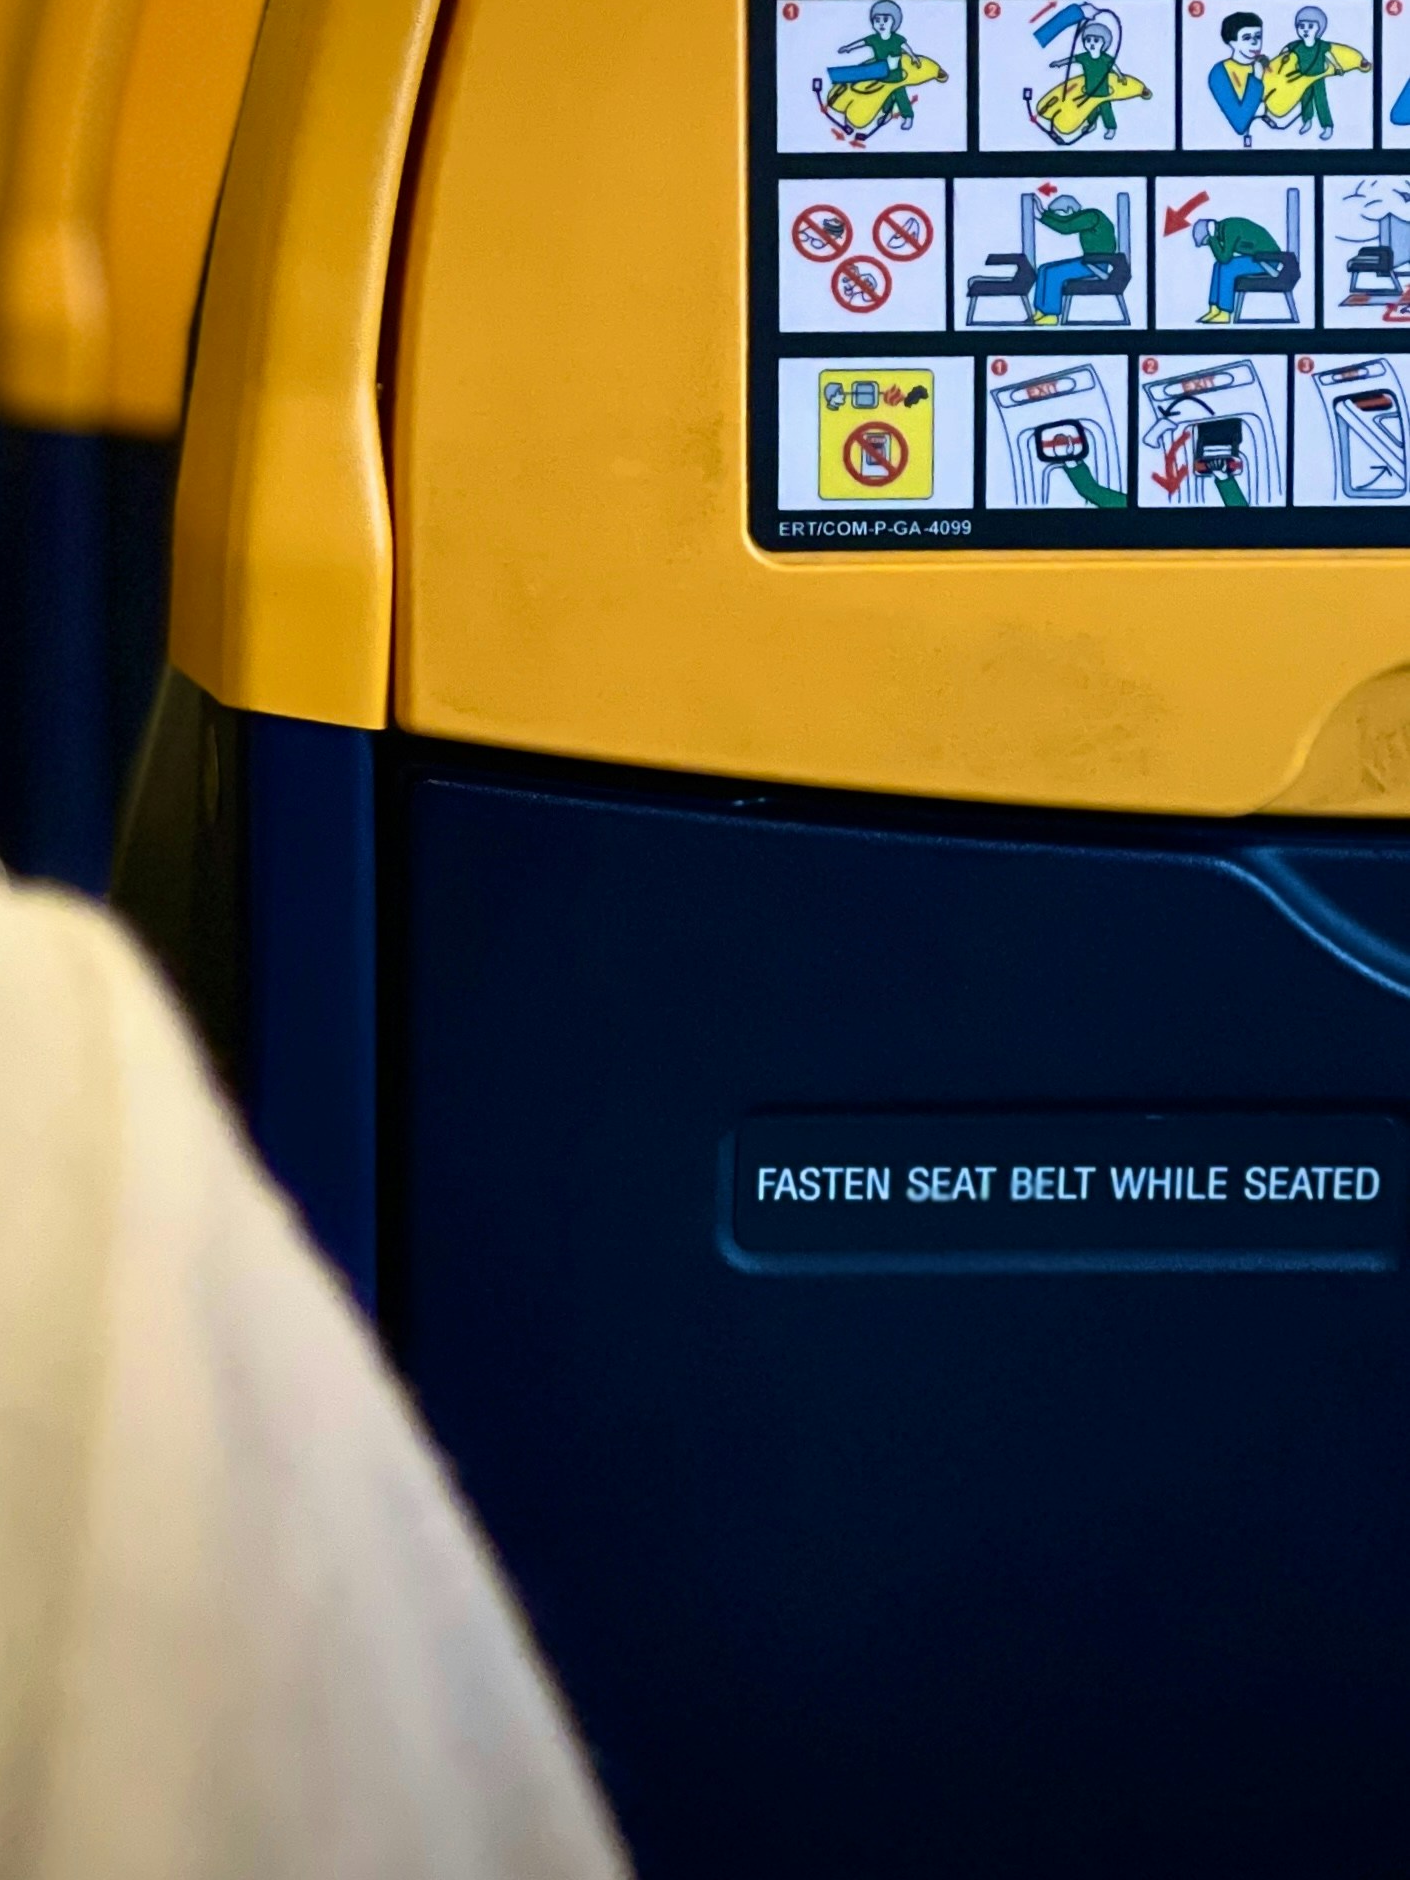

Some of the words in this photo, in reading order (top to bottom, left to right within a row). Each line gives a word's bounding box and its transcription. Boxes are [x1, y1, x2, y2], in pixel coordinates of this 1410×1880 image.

[778, 520, 972, 537] ERT/COM-P-GA-4099
[757, 1166, 891, 1201] FASTEN
[906, 1166, 997, 1201] SEAT
[1010, 1166, 1096, 1200] BELT
[1110, 1166, 1229, 1201] WHILE
[1244, 1166, 1380, 1201] SEATED
